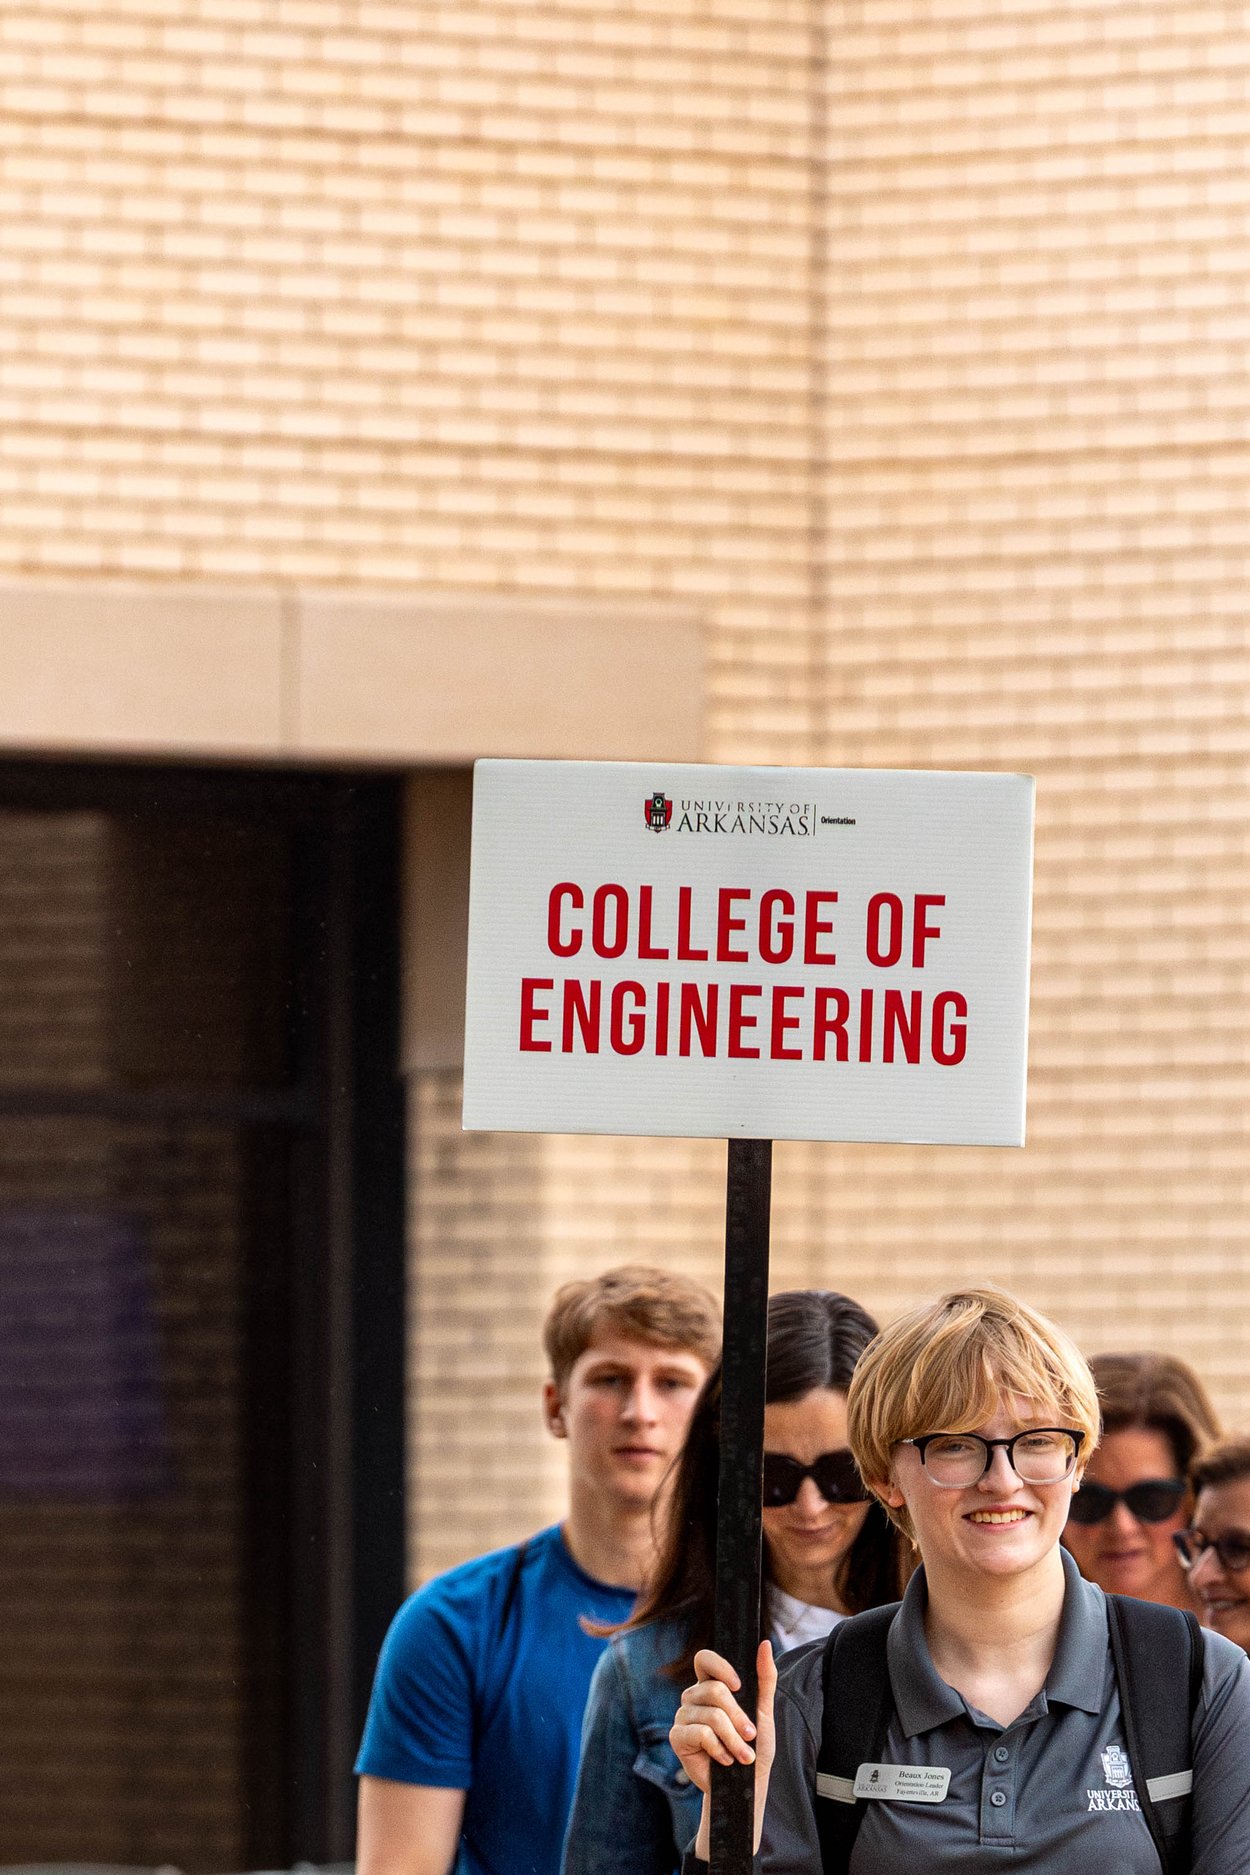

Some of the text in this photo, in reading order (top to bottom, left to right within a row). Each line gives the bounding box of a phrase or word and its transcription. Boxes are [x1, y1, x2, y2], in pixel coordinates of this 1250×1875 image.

[789, 803, 810, 815] OF
[820, 815, 857, 826] Orientation
[547, 881, 946, 969] COLLEGE OF
[518, 977, 968, 1067] ENGINEERING
[898, 1770, 945, 1780] Beaux Jones
[1087, 1799, 1142, 1812] ARKANS
